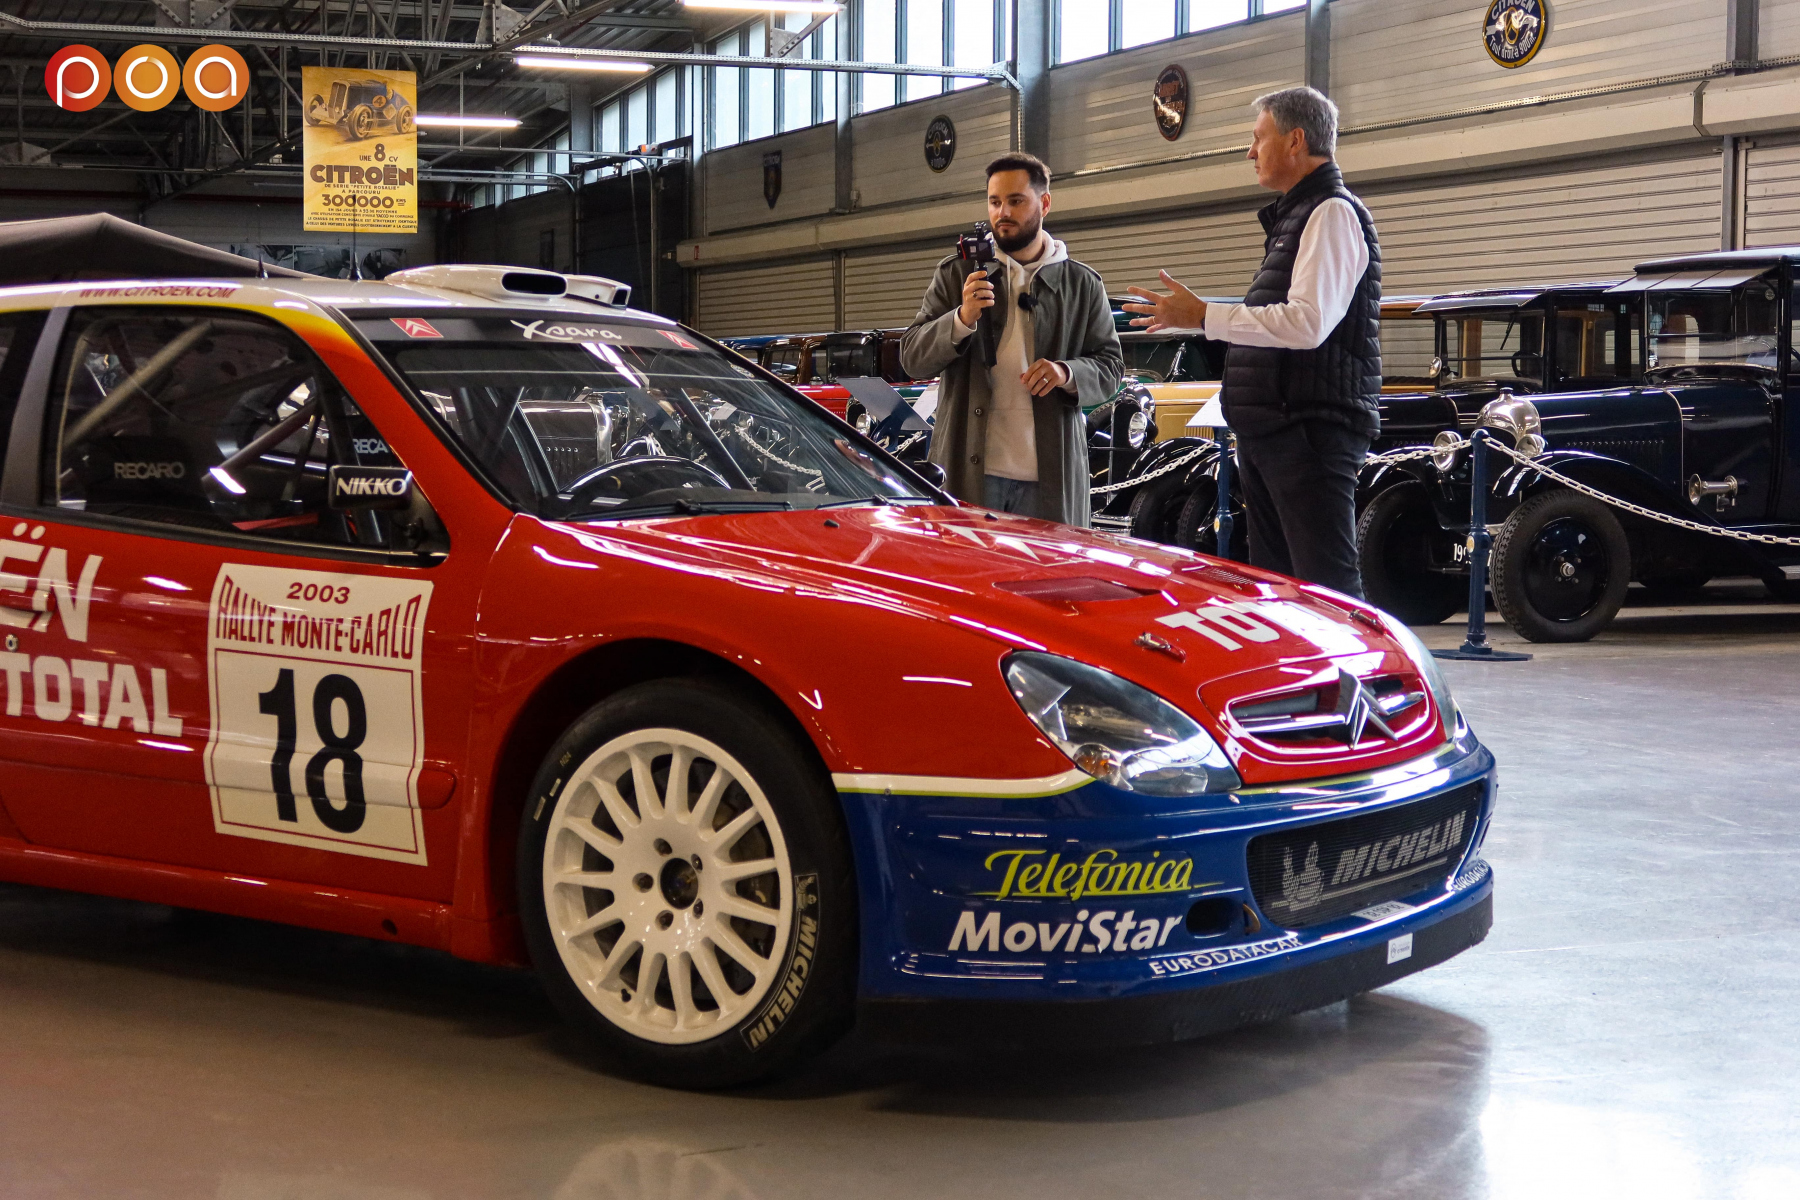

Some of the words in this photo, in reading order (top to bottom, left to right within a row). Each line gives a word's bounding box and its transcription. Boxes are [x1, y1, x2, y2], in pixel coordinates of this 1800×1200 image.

[374, 143, 386, 162] 8
[310, 164, 414, 186] CITROËN
[322, 194, 394, 209] 300000
[510, 319, 622, 341] Xsara
[114, 462, 185, 480] RECARO
[336, 477, 408, 496] NIKKO
[286, 582, 350, 604] 2003
[216, 574, 276, 645] RALLYE
[281, 594, 422, 660] MONTE-CARLO
[0, 652, 184, 738] TOTAL
[258, 668, 367, 834] 18
[1331, 810, 1467, 885] MICHELIN
[948, 909, 1184, 954] MoviStar
[1149, 936, 1303, 975] EURODATACAR
[748, 915, 818, 1049] MICHELIN
